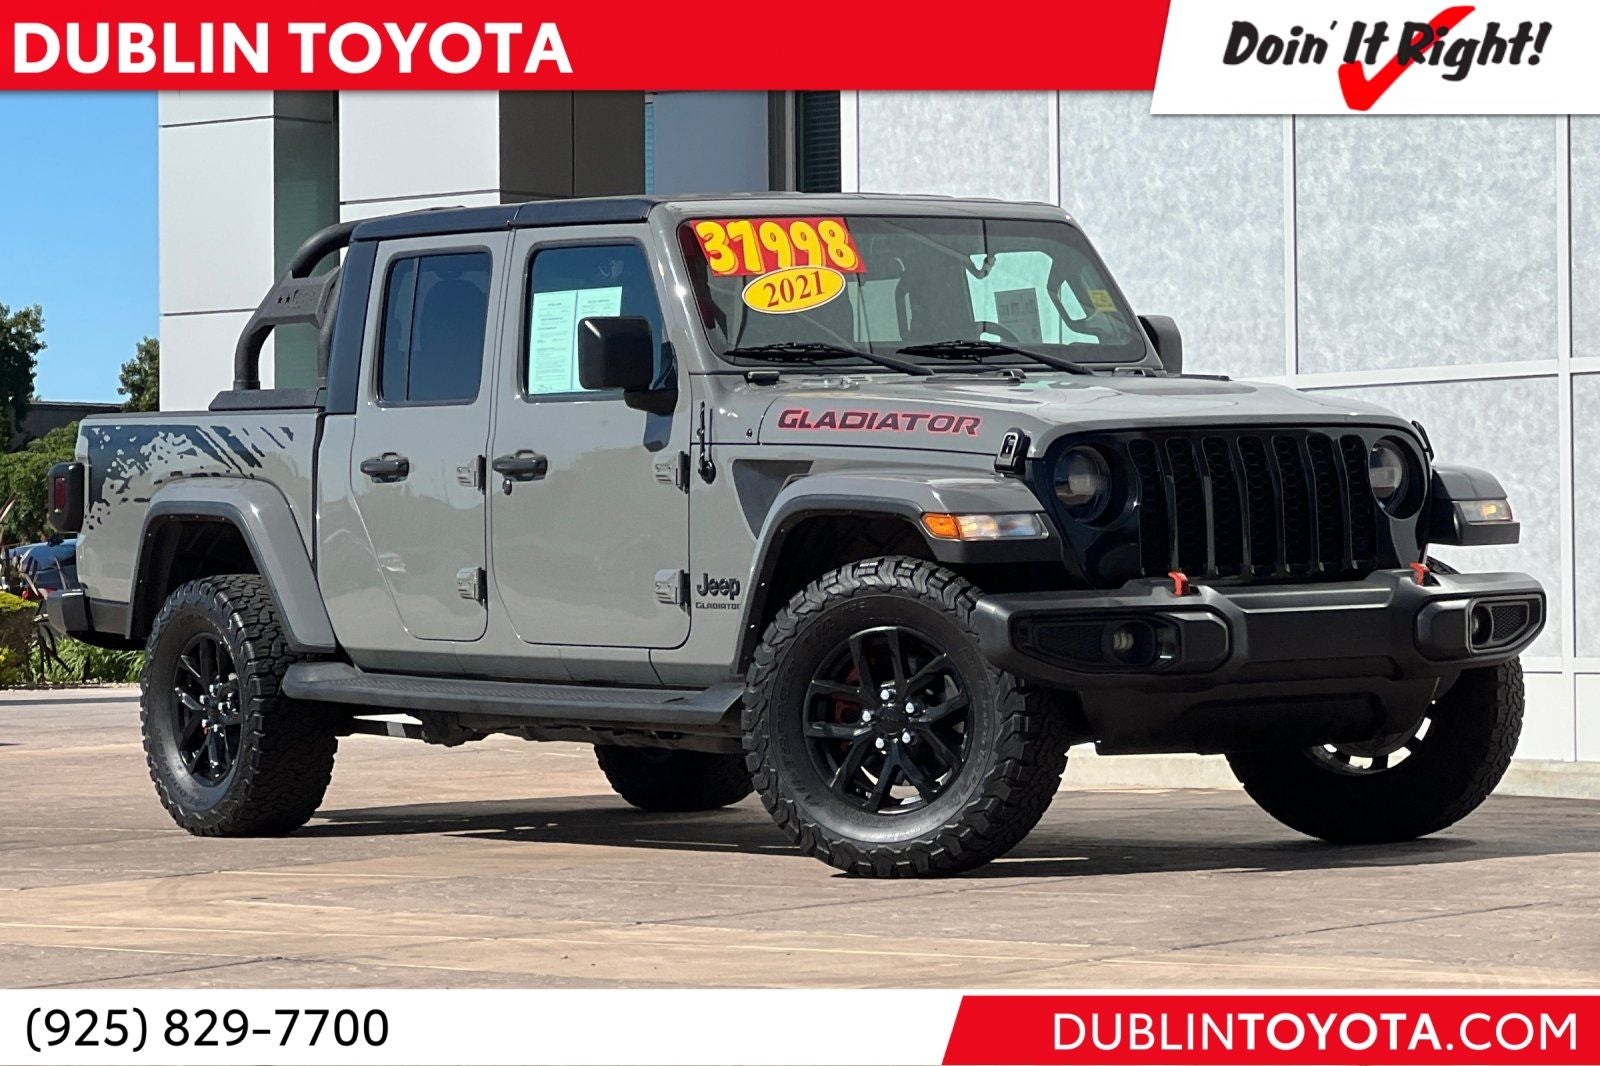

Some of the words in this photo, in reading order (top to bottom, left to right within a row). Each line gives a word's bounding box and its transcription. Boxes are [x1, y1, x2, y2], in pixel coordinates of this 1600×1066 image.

[695, 219, 859, 275] 37998
[763, 270, 825, 308] 2021
[777, 407, 982, 437] GLADIATOR
[696, 572, 741, 601] Jeep
